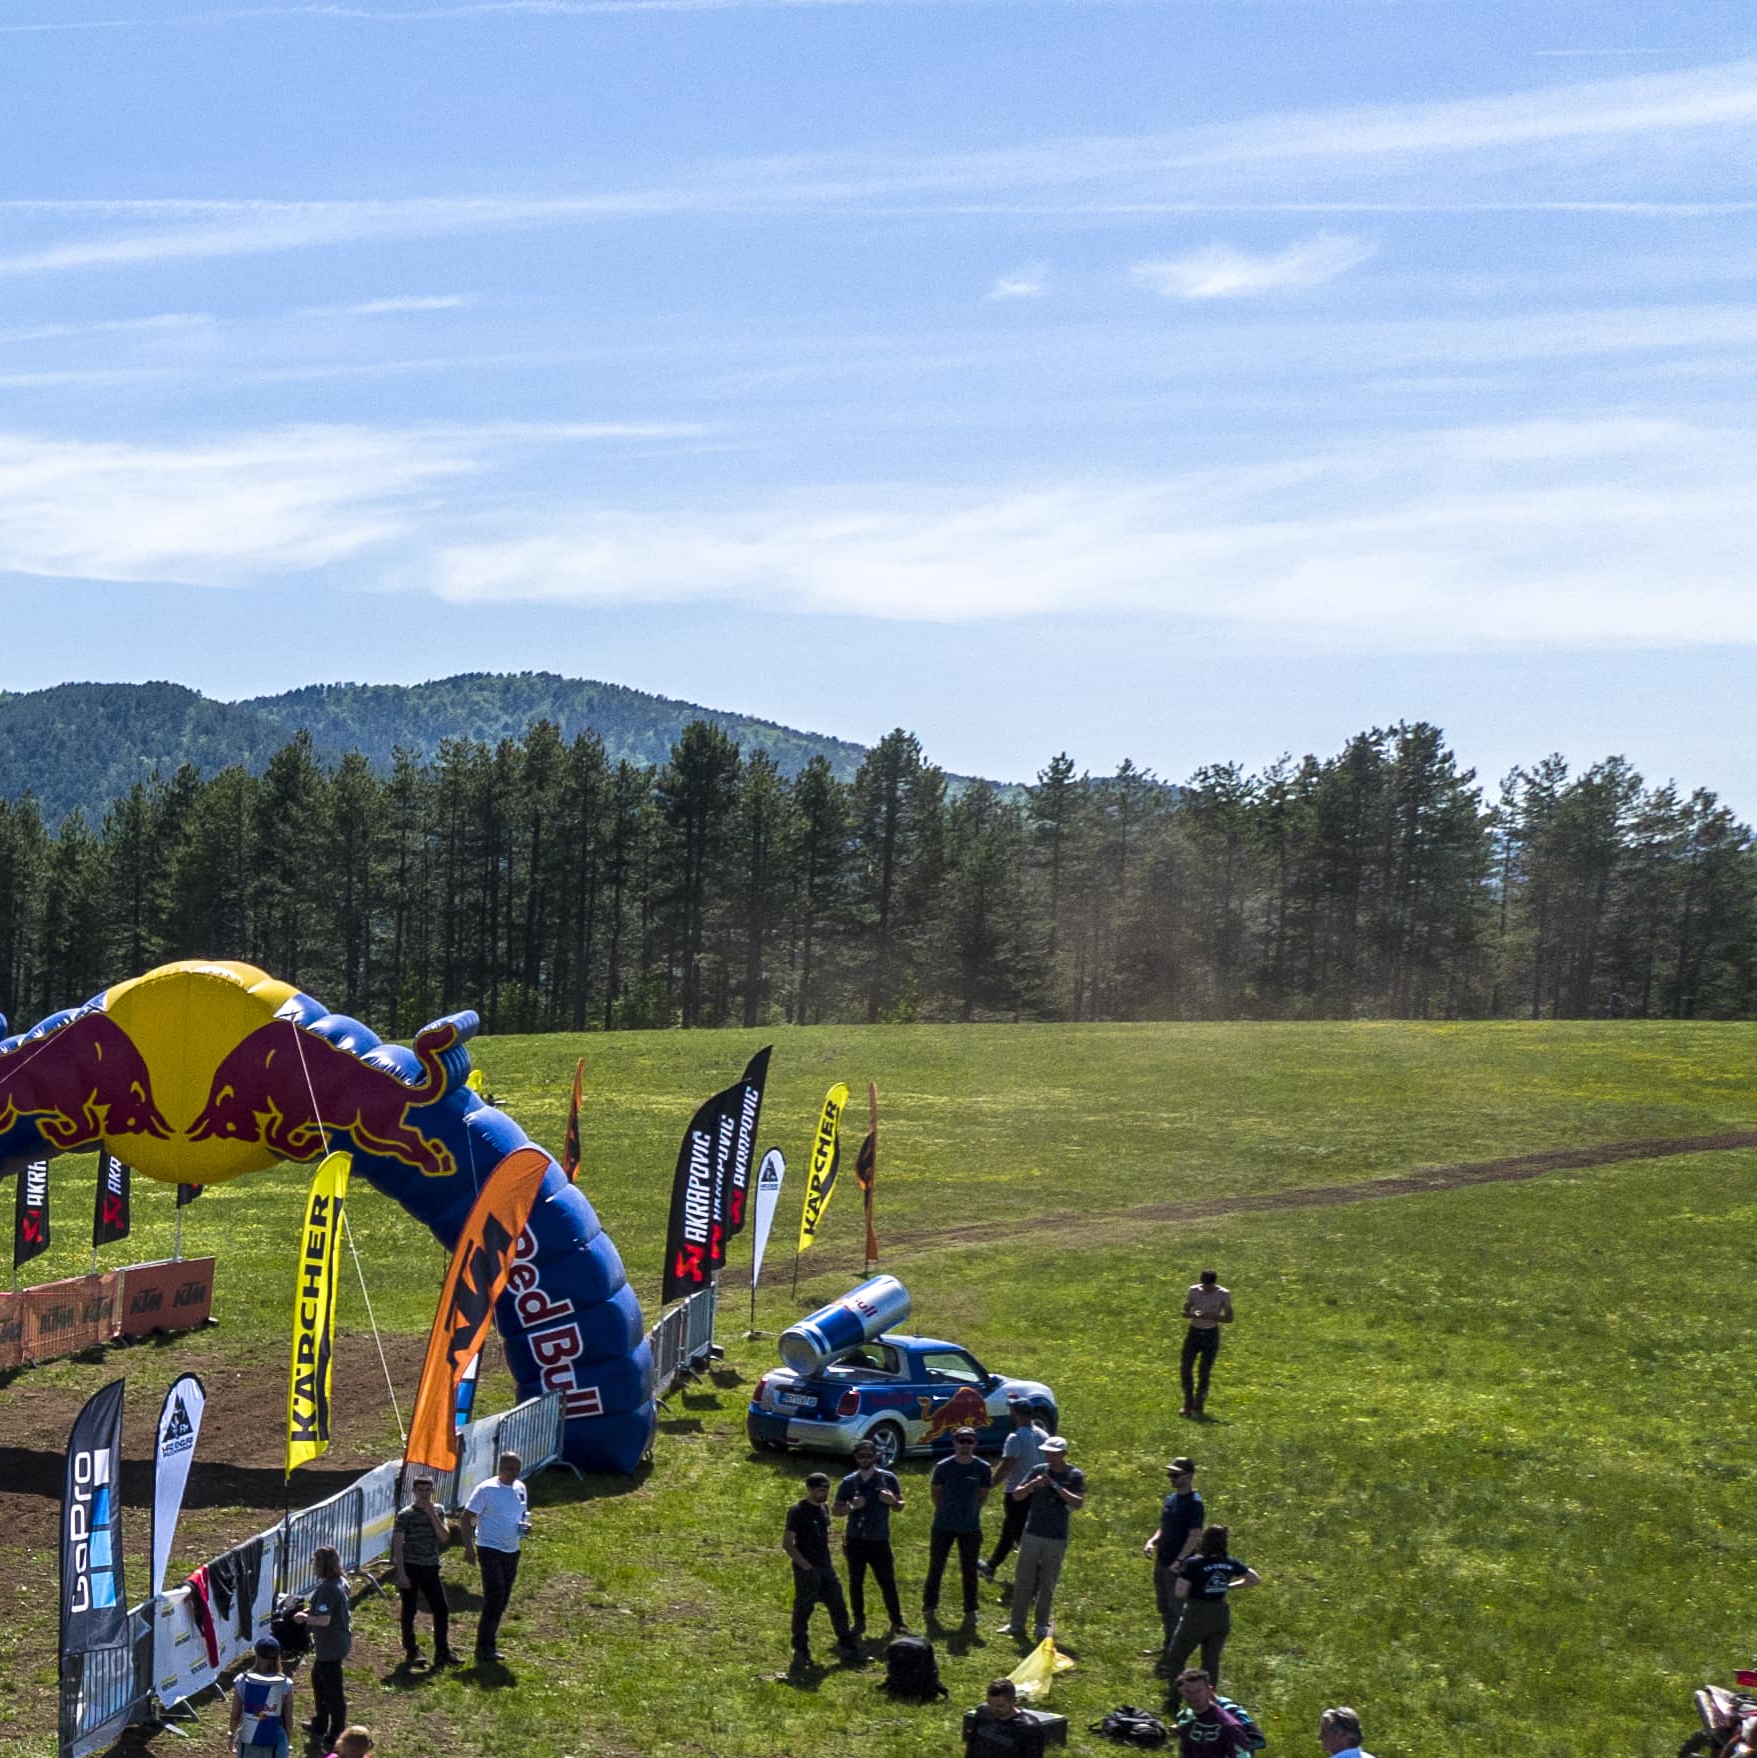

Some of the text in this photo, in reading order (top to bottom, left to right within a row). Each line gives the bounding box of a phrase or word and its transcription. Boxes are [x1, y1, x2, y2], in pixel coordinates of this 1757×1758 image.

[130, 1288, 163, 1314] KTM
[172, 1282, 206, 1307] KTM
[290, 1194, 330, 1442] KÄRCHER
[528, 1321, 604, 1420] Bull
[70, 1451, 92, 1614] GoPro
